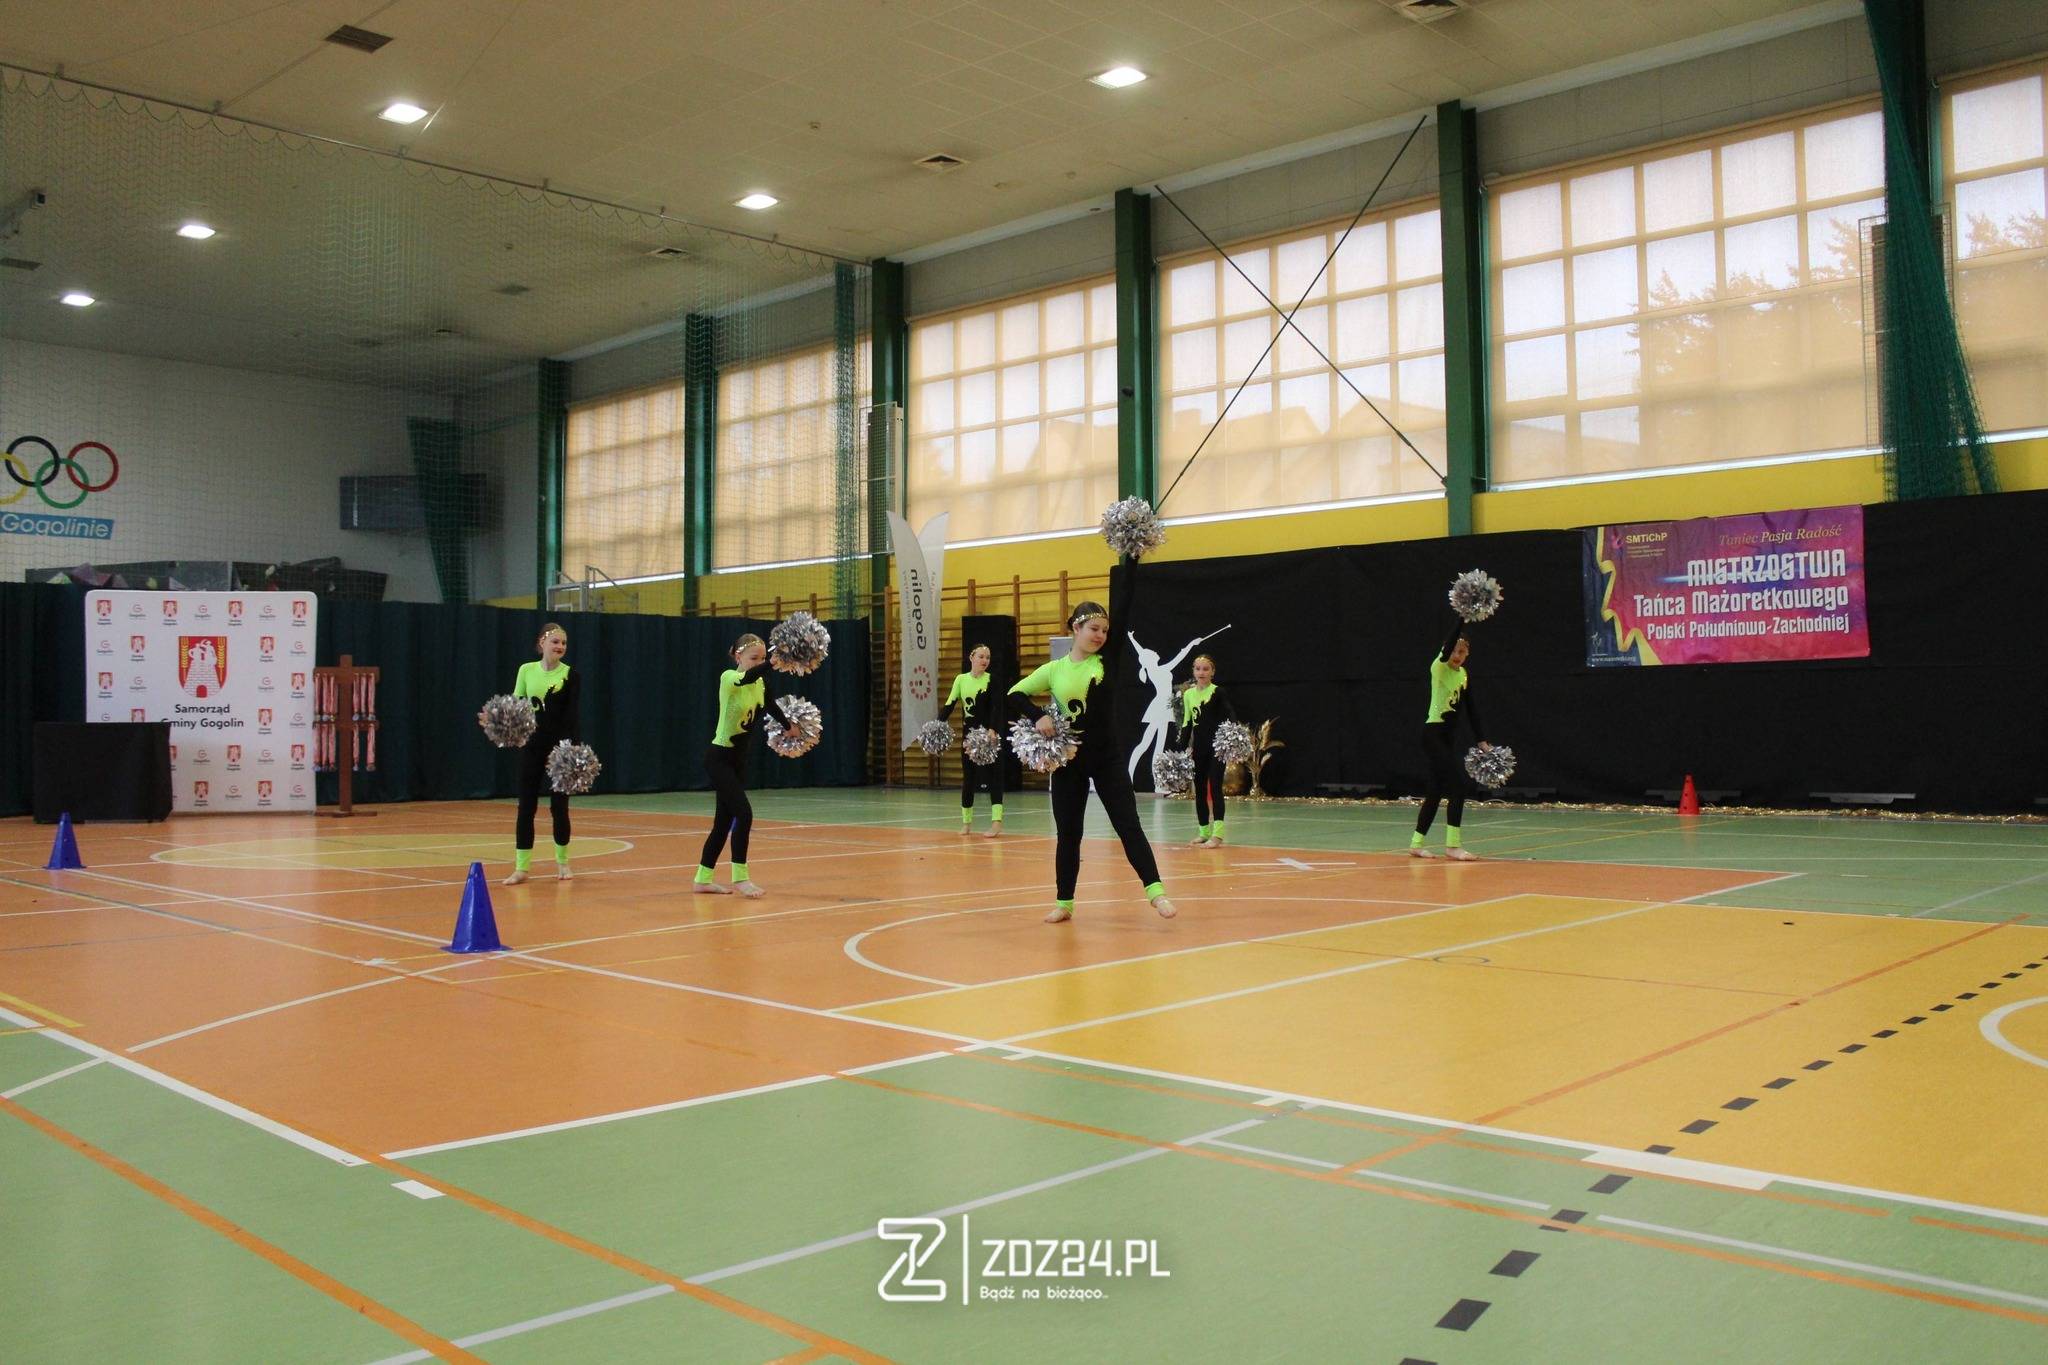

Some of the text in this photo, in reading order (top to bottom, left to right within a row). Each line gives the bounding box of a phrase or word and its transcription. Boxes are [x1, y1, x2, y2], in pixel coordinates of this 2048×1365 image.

[2, 513, 109, 537] Gogolinie
[1761, 529, 1793, 544] Pasja
[1796, 523, 1842, 540] Radość
[1625, 532, 1668, 544] SMTiChP
[1687, 549, 1846, 587] MISTRZOSTWA
[1634, 585, 1849, 617] Tańca Mażoretkowego
[1647, 613, 1850, 640] Polski Południowo-Zachodniej
[175, 704, 230, 715] Samorząd
[200, 718, 244, 730] Gogolin
